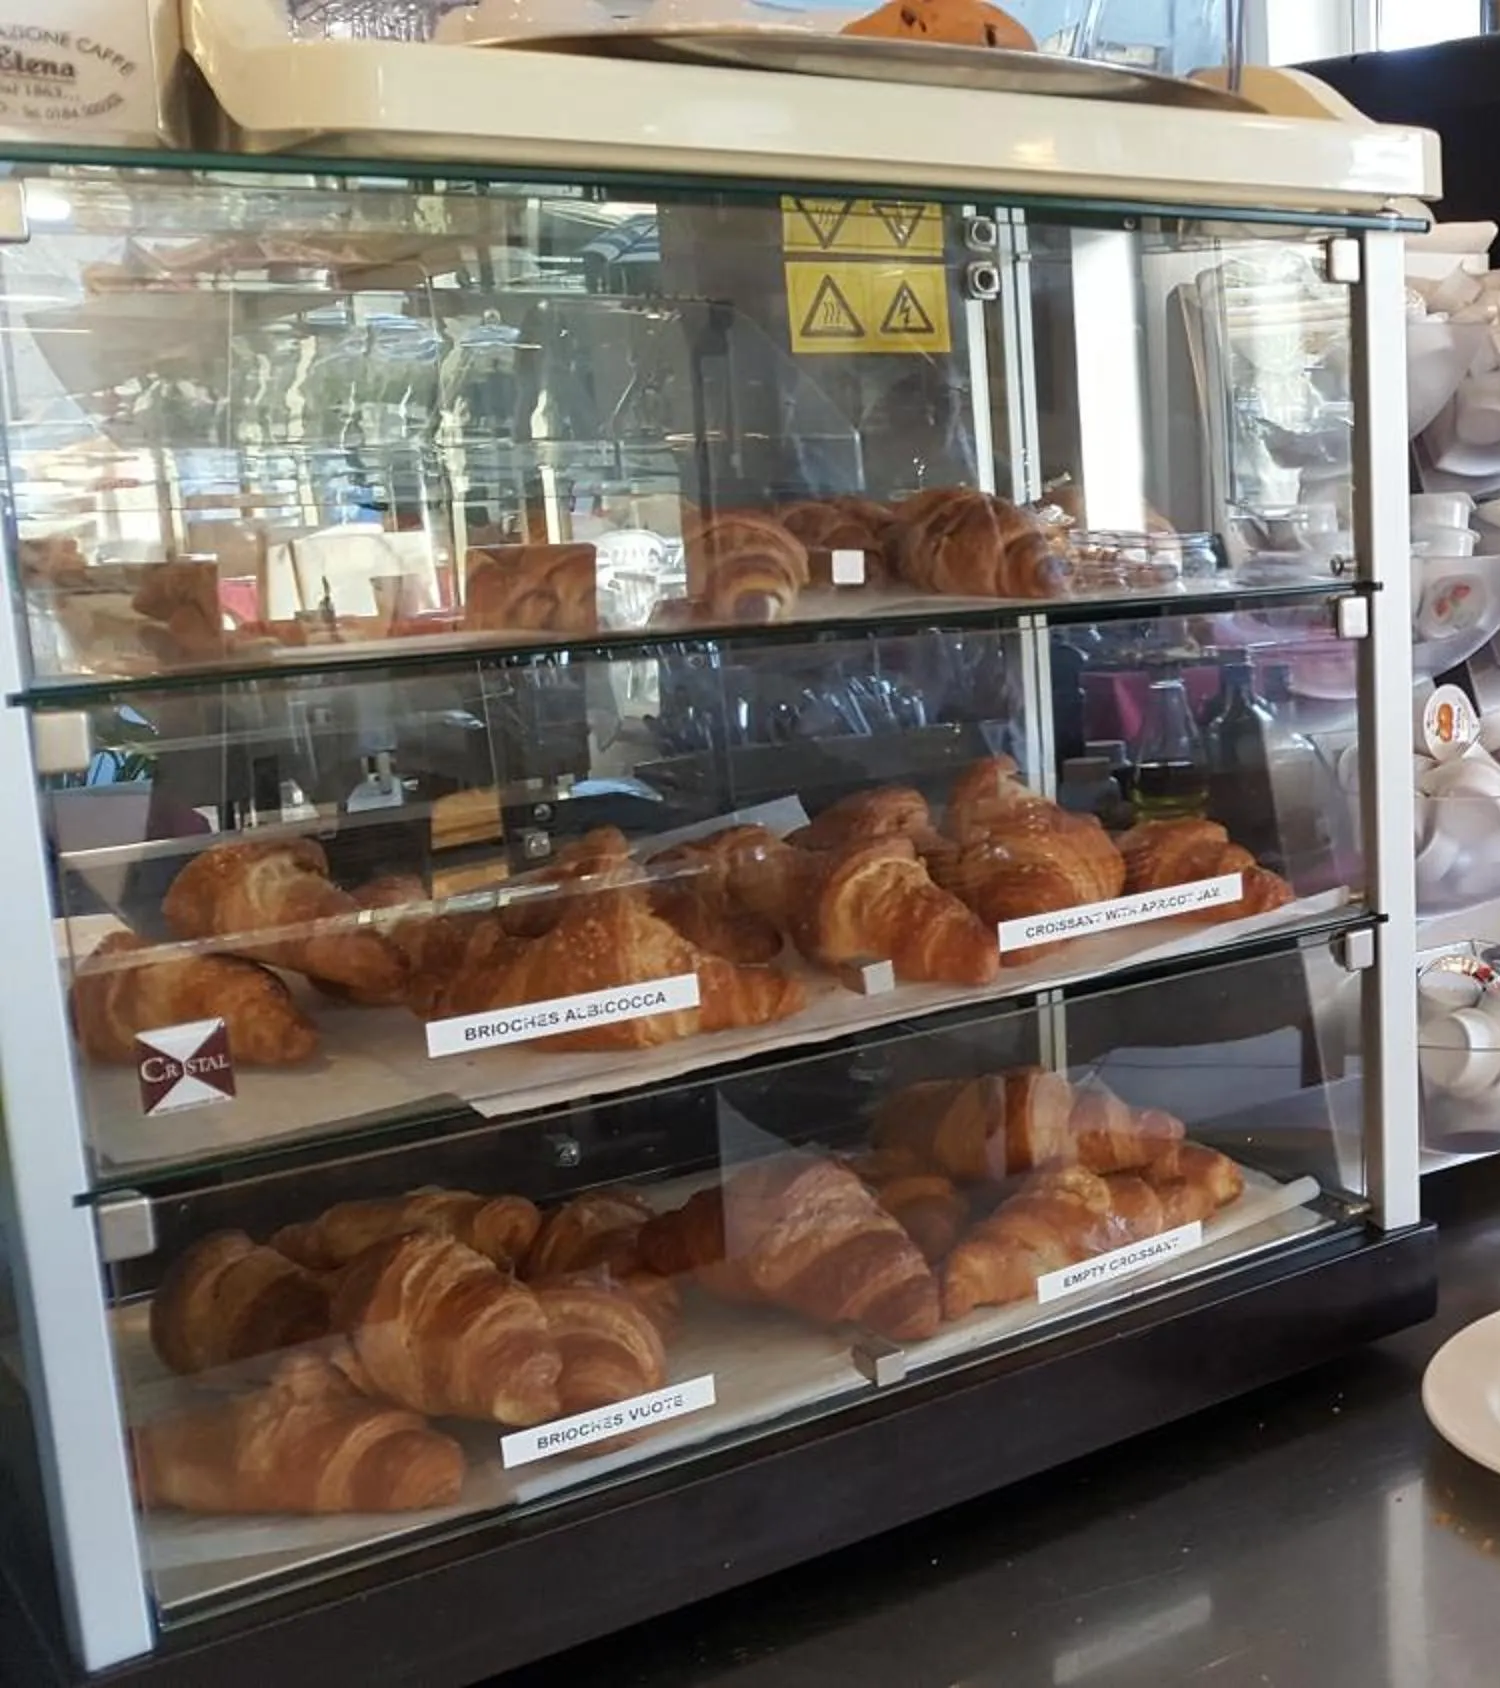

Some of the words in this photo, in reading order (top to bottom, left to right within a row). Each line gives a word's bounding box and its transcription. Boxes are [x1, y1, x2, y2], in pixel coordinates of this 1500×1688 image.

[463, 1012, 560, 1042] BRIOCHES
[564, 991, 668, 1023] ALBICOCCA
[1063, 1263, 1107, 1289] EMPTY
[536, 1413, 624, 1450] BRIOCHES
[628, 1394, 684, 1422] VUOTE
